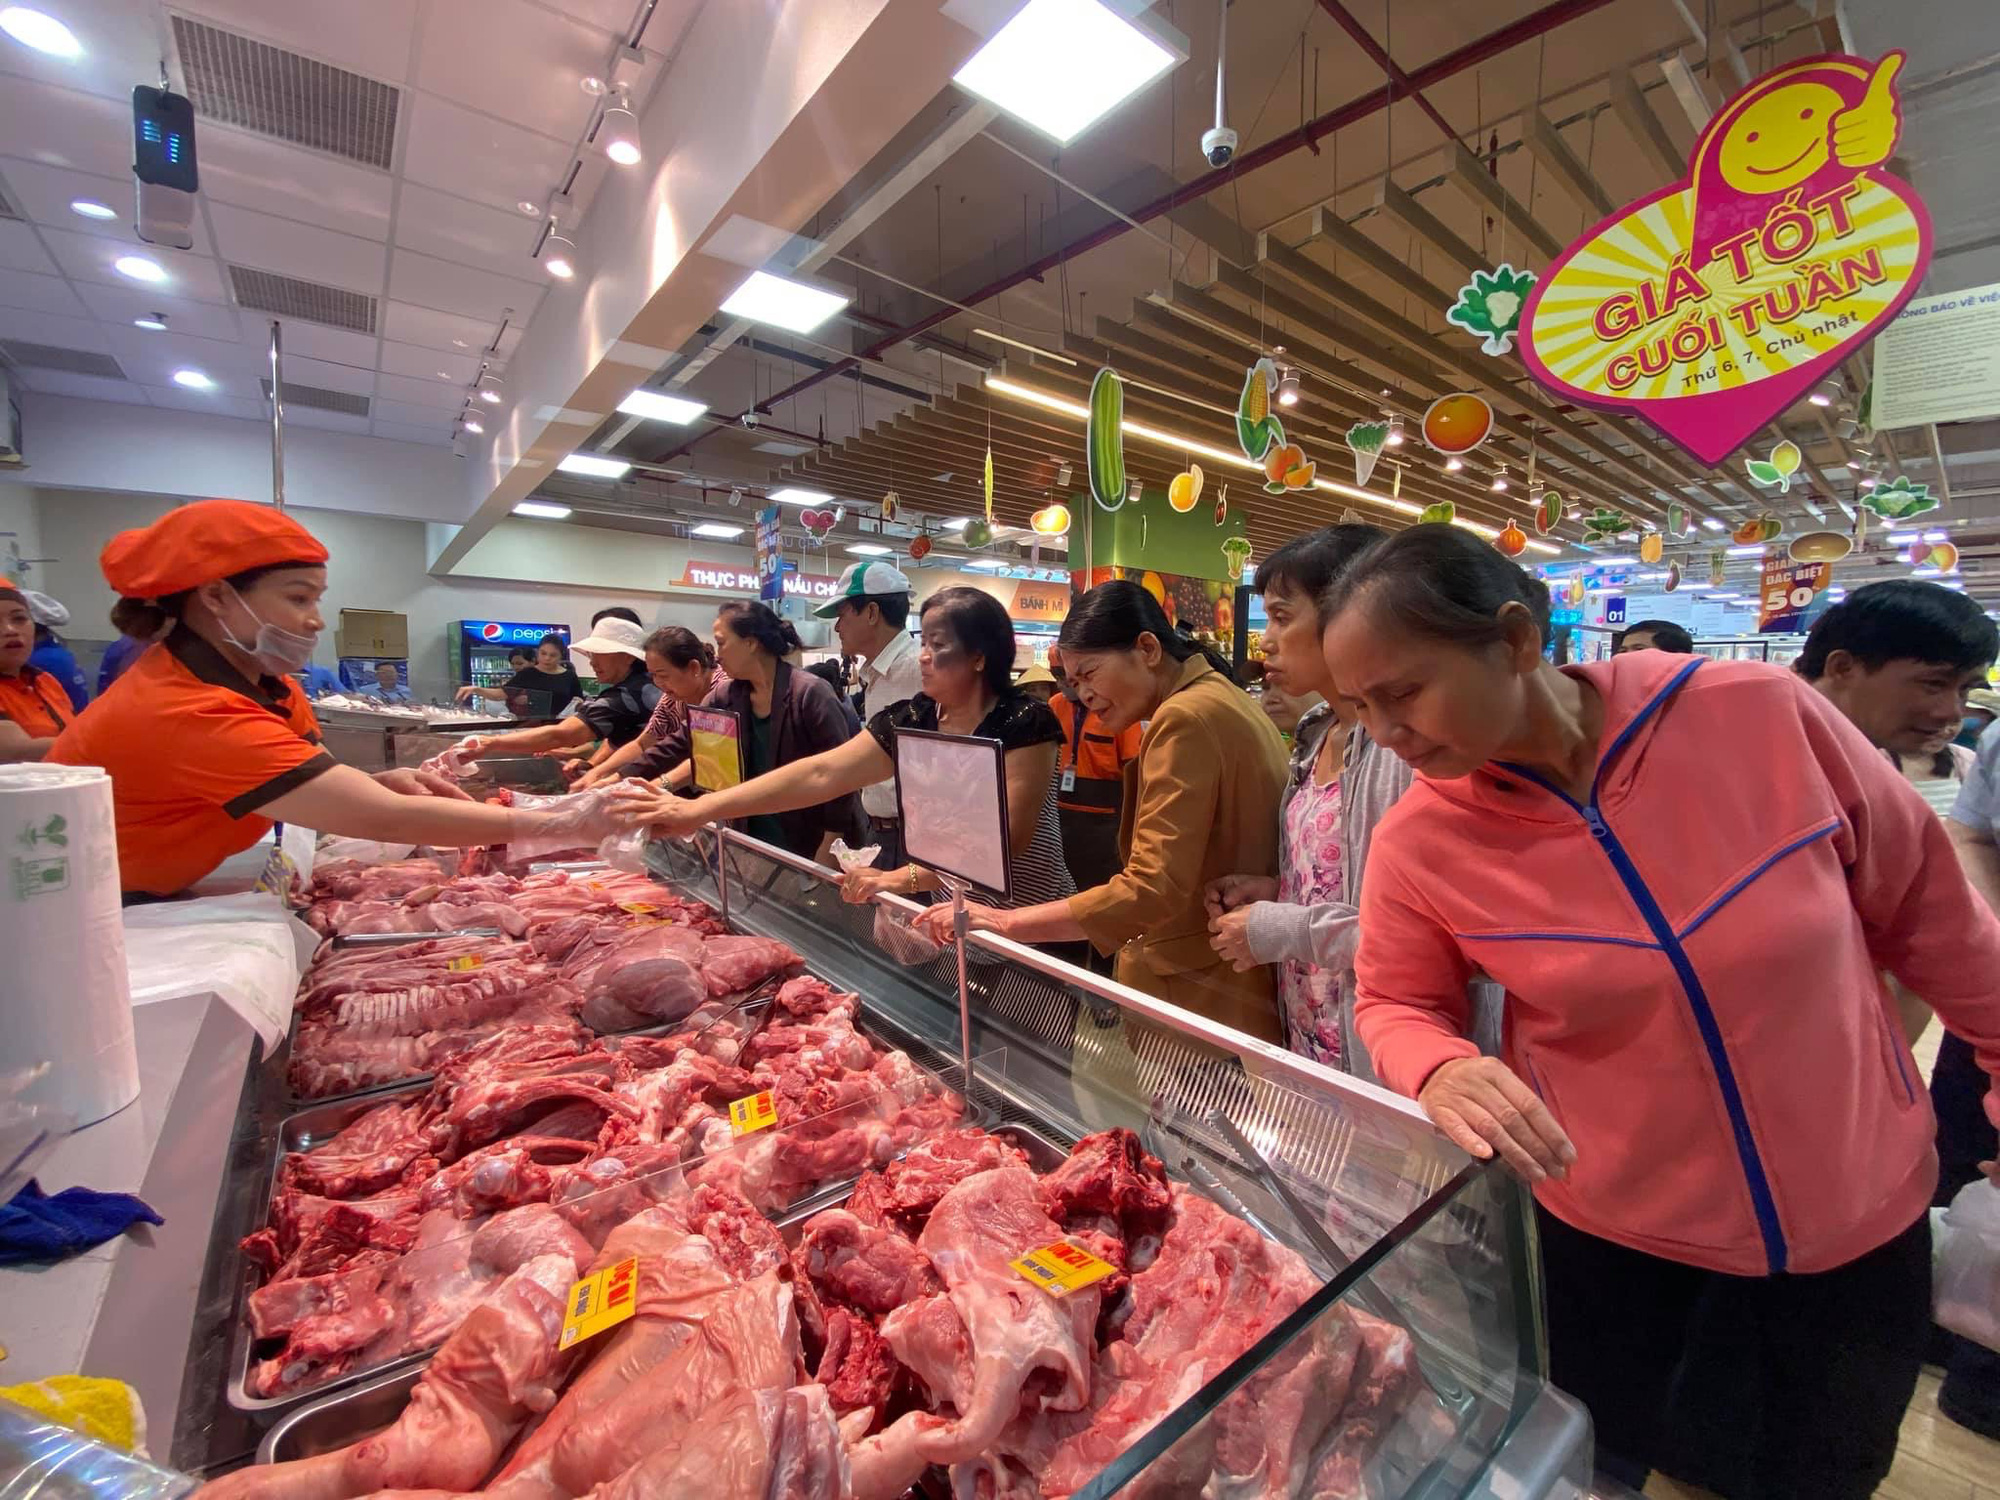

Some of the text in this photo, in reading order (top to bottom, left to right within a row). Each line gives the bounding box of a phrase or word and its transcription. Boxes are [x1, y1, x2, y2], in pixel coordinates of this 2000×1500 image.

[1592, 179, 1862, 341] GIÁ TỐT
[1605, 246, 1887, 390] CUỐI TUẦN
[1682, 365, 1717, 388] Thứ
[1766, 330, 1806, 354] Chủ
[1812, 310, 1859, 337] nhật
[738, 574, 760, 590] PH
[814, 581, 838, 596] CHÍ
[1020, 595, 1048, 610] BÁNH
[1608, 610, 1624, 622] 01
